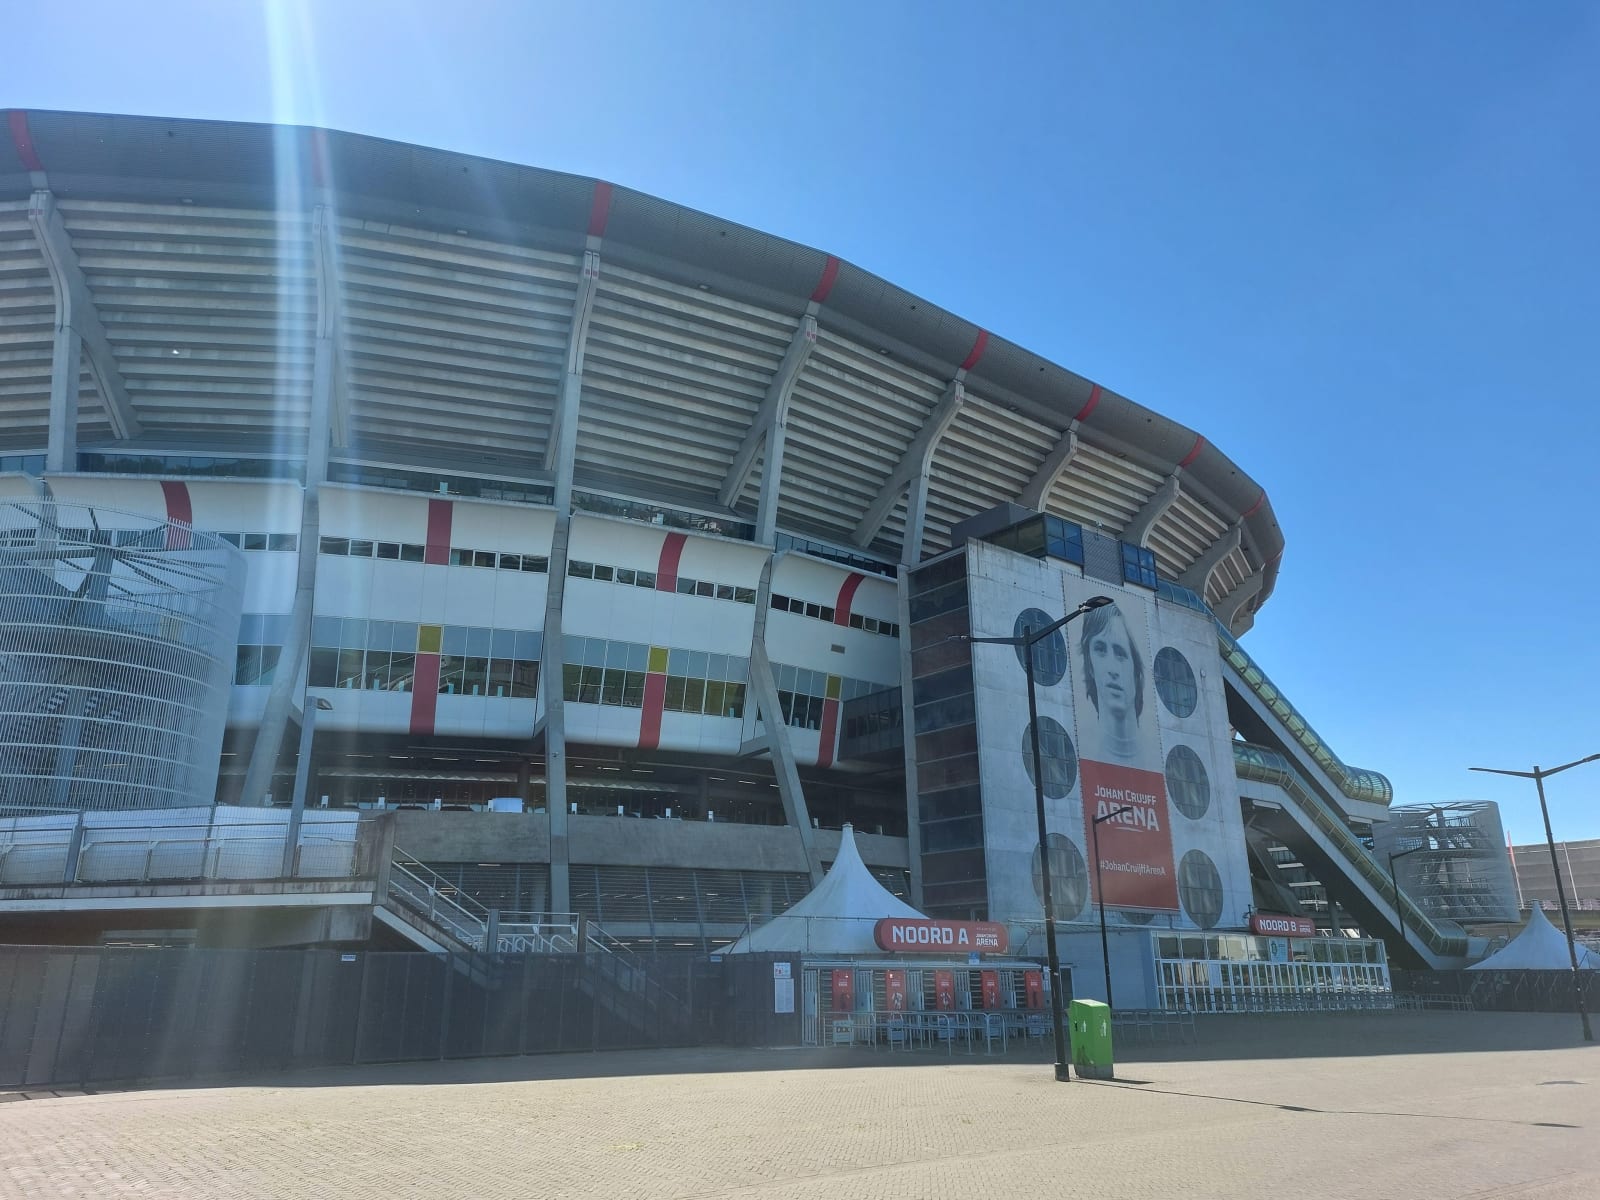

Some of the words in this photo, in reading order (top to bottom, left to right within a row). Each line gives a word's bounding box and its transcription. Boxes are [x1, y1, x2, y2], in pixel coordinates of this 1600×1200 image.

[1094, 785, 1123, 800] JOHAN
[1097, 800, 1159, 831] ARENA
[1259, 919, 1289, 931] NOORD
[1291, 921, 1297, 931] B
[892, 926, 953, 945] NOORD
[958, 927, 969, 945] A
